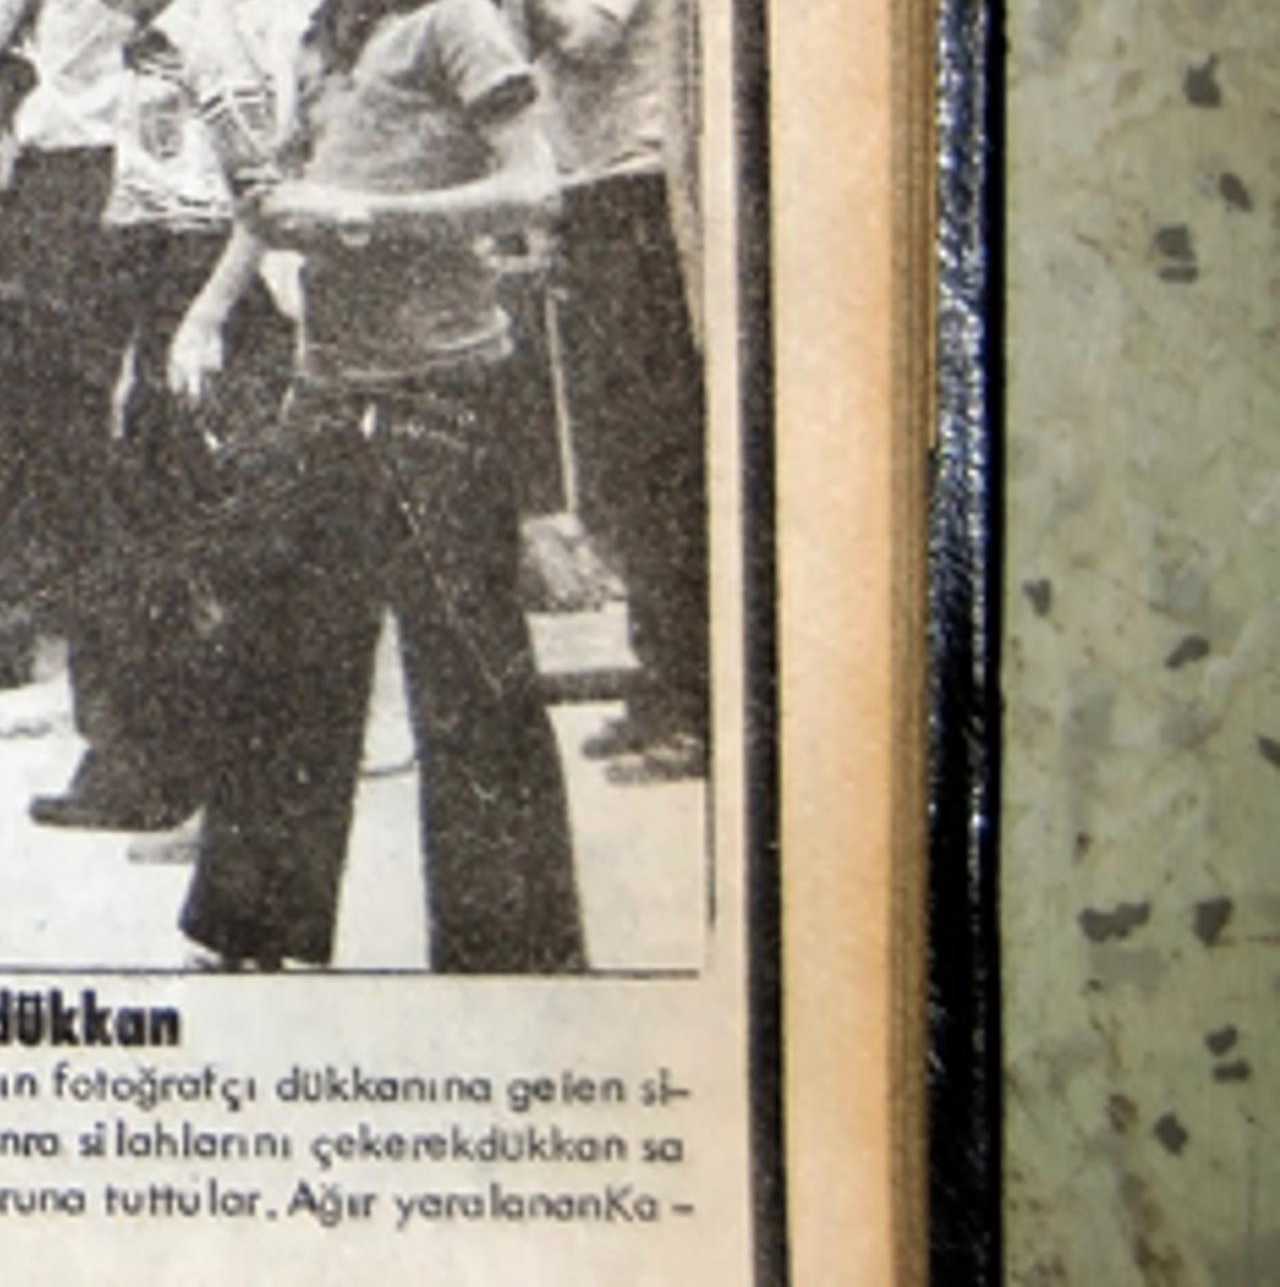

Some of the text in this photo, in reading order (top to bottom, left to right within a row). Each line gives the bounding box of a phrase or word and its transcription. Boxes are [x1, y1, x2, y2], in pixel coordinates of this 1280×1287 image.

[52, 1060, 257, 1114] fotoğrafçı
[275, 1065, 494, 1104] dükkanına
[506, 1071, 628, 1114] gelen
[79, 1119, 292, 1161] silahlarını
[642, 1138, 684, 1165] sa
